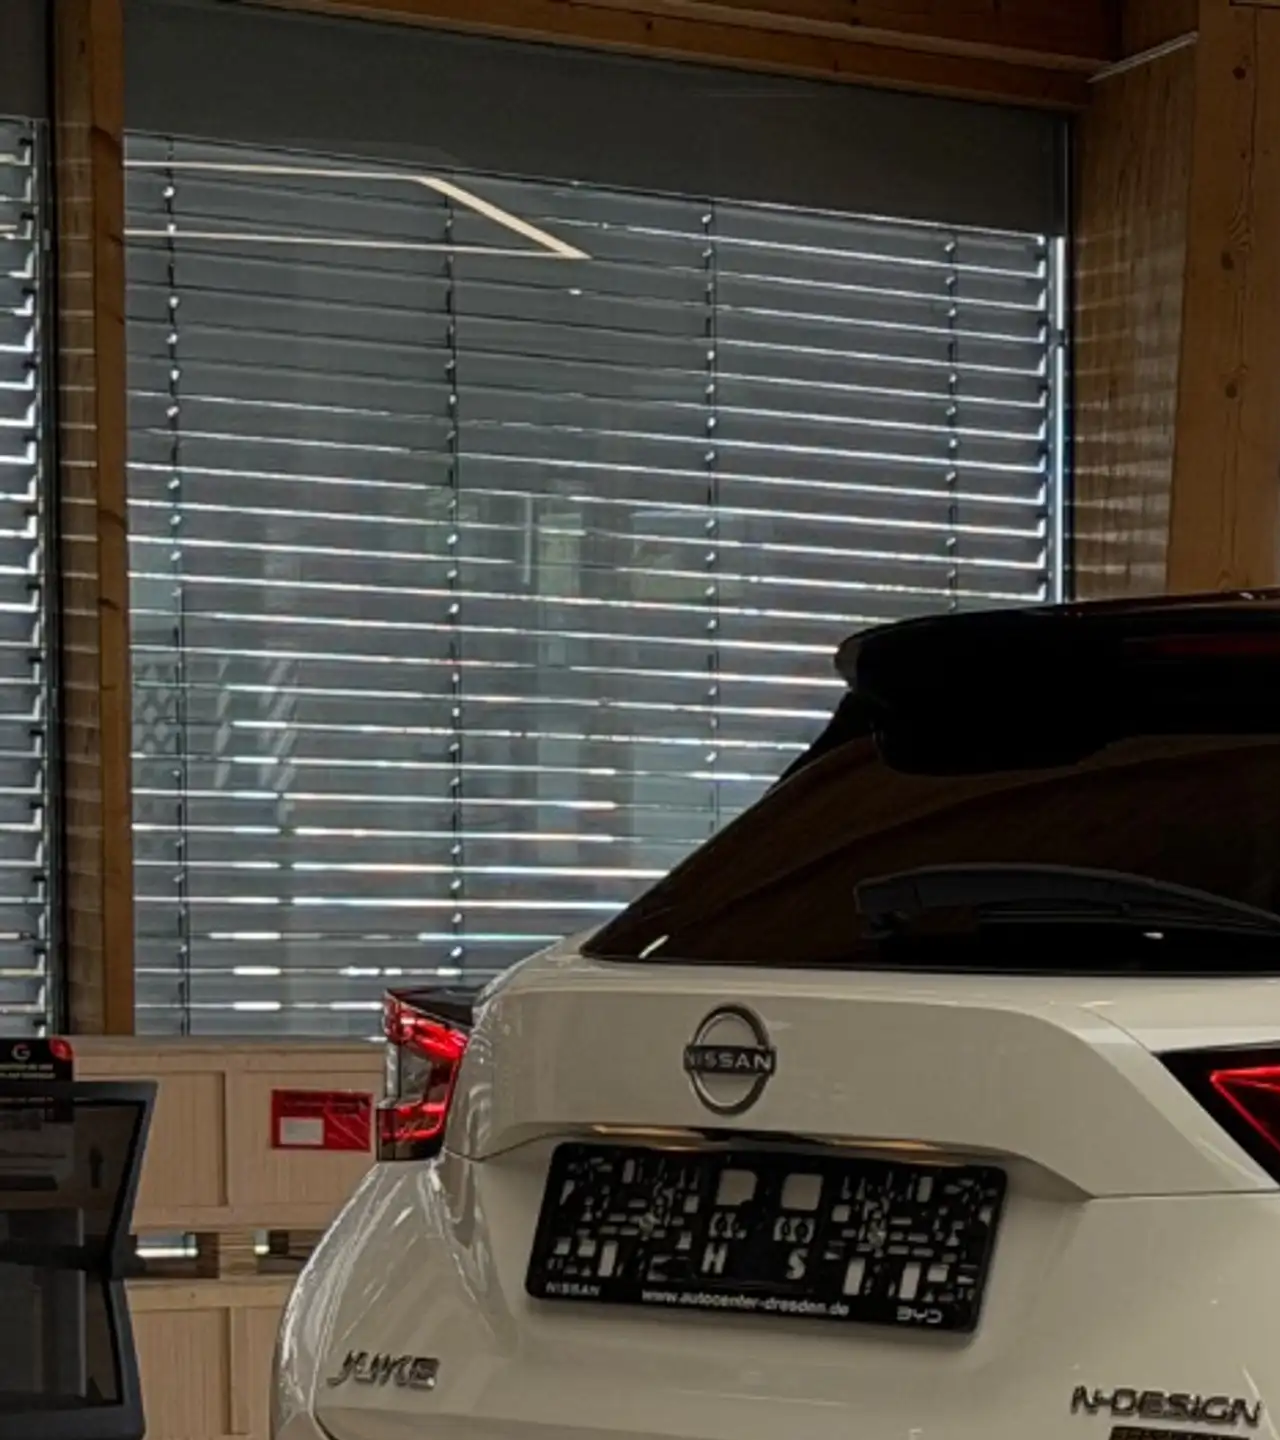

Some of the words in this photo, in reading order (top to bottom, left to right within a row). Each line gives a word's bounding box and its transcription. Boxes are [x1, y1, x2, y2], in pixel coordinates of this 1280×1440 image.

[686, 1050, 773, 1071] NISSAN
[545, 1281, 601, 1297] NISSAN
[896, 1304, 944, 1325] BYD
[326, 1350, 440, 1392] JUKE
[1070, 1385, 1261, 1428] N-DESIGN
